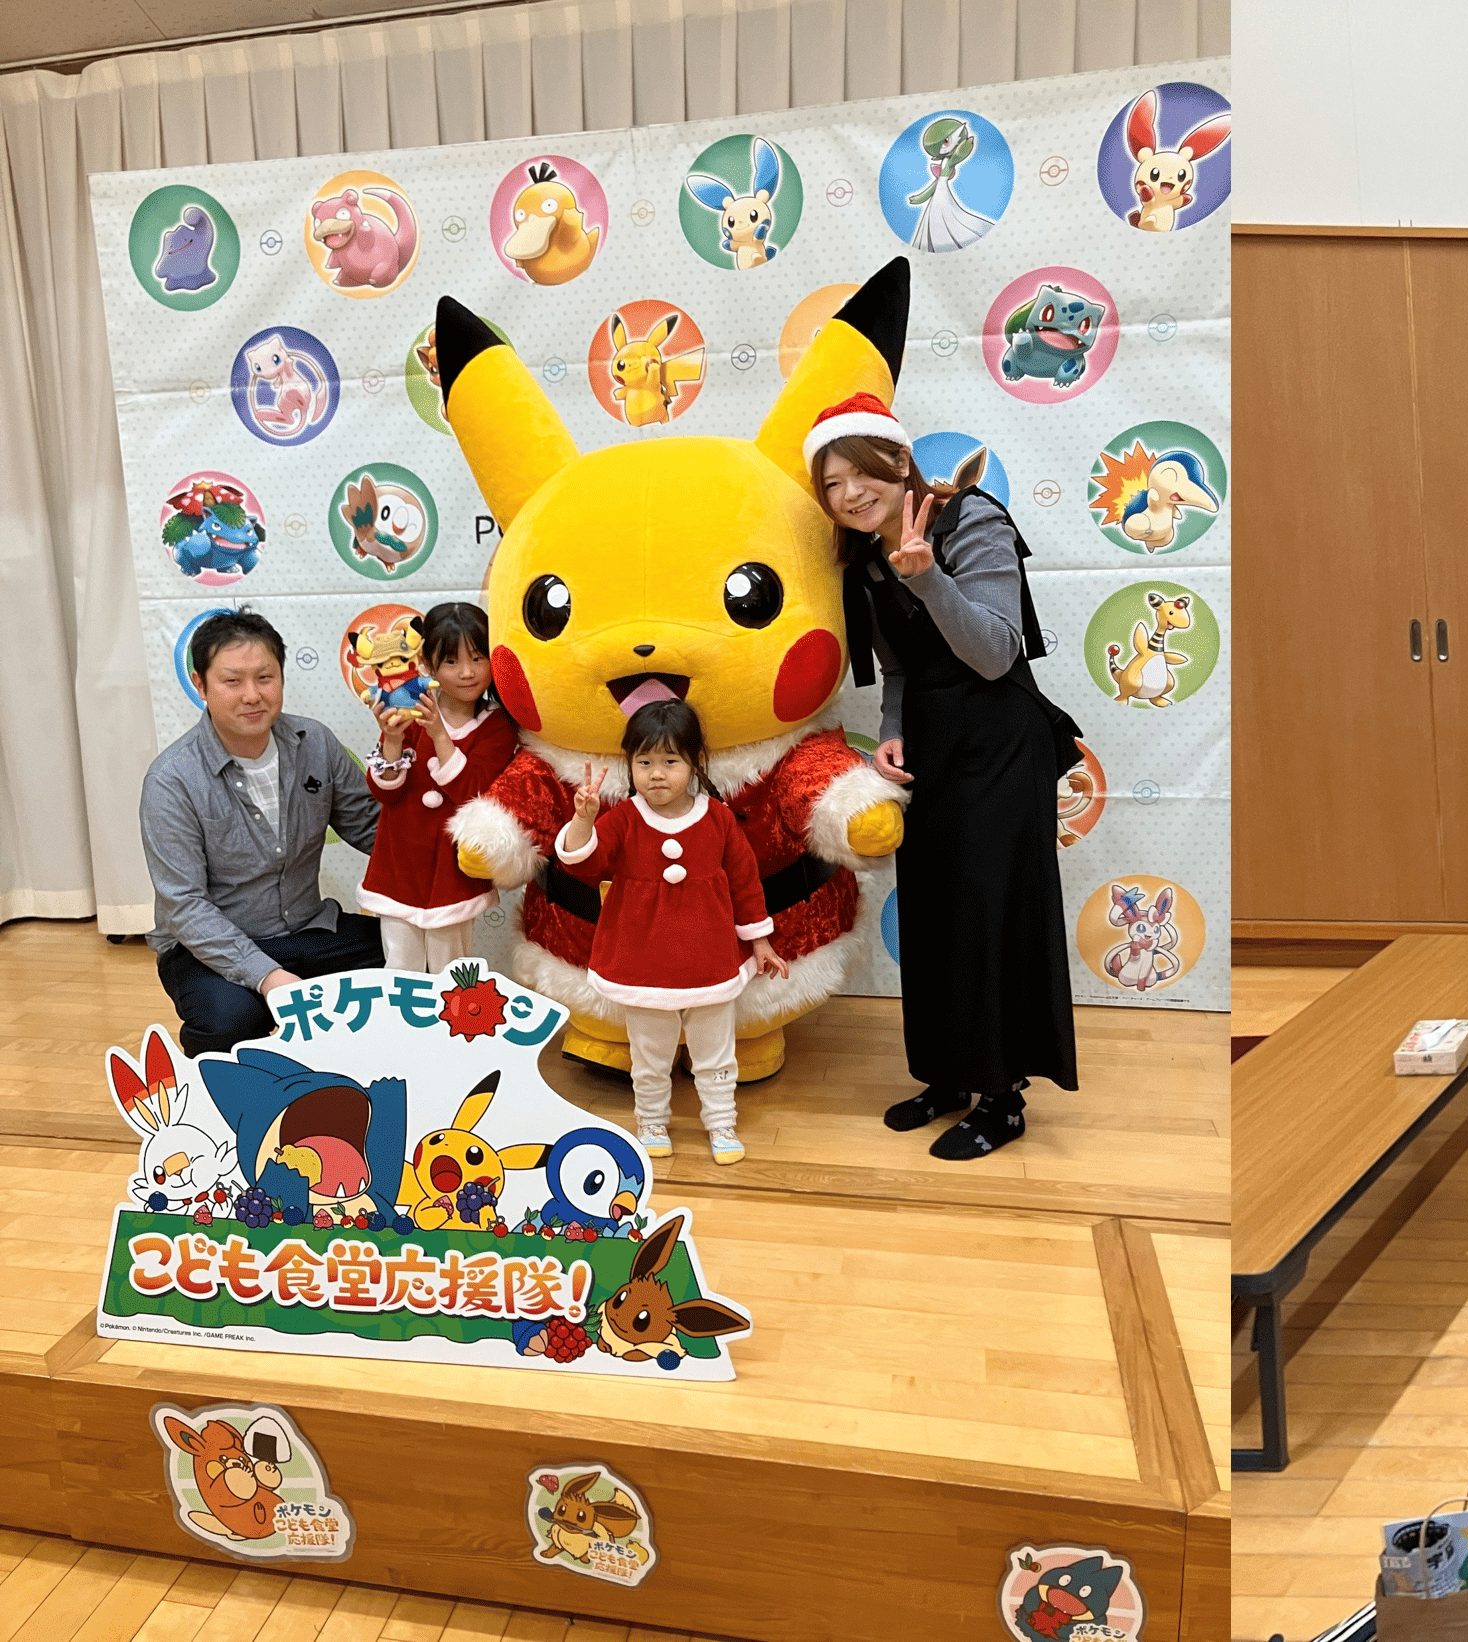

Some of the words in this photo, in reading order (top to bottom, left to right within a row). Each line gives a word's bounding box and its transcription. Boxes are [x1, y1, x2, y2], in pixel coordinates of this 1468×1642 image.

[475, 515, 504, 545] P
[276, 976, 562, 1046] ポケモン
[132, 1237, 588, 1318] こども食堂応援隊!
[276, 1503, 332, 1518] ポケモン
[275, 1518, 339, 1532] こども食堂
[594, 1541, 637, 1559] ポケモン
[1076, 1625, 1126, 1639] ポケモン
